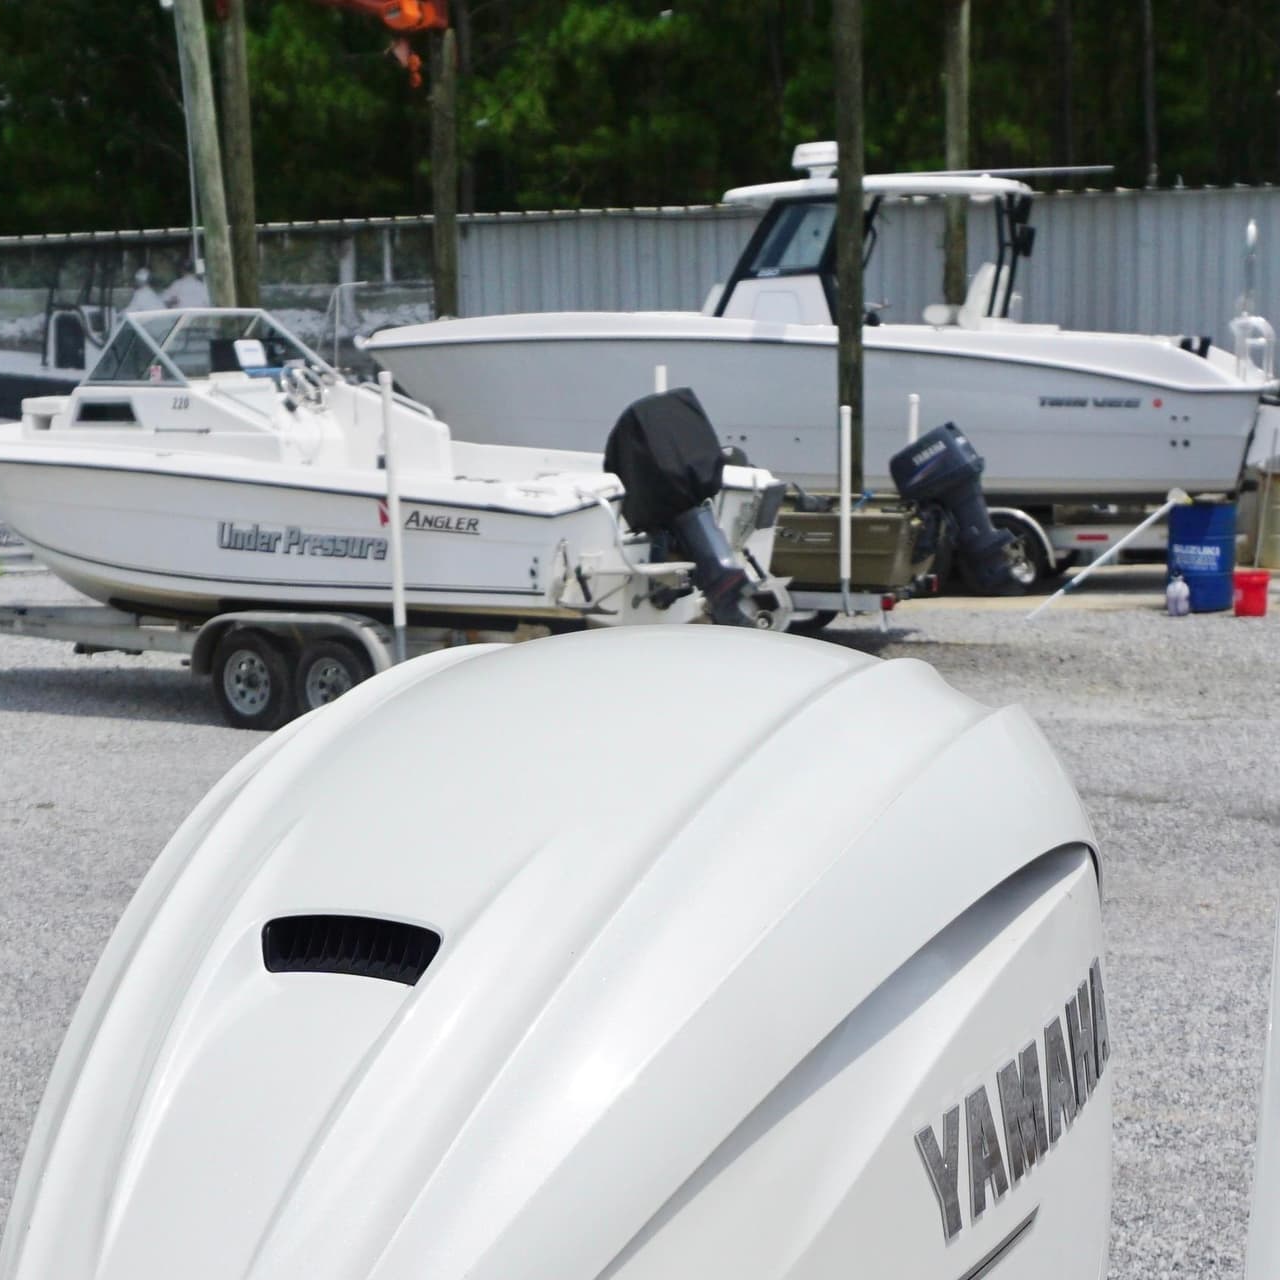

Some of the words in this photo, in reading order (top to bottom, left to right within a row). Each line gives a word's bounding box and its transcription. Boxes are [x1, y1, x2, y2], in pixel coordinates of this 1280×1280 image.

[217, 521, 282, 553] Under
[282, 525, 389, 561] Pressure
[404, 511, 480, 533] ANGLER
[914, 956, 1111, 1242] YAMAHA
